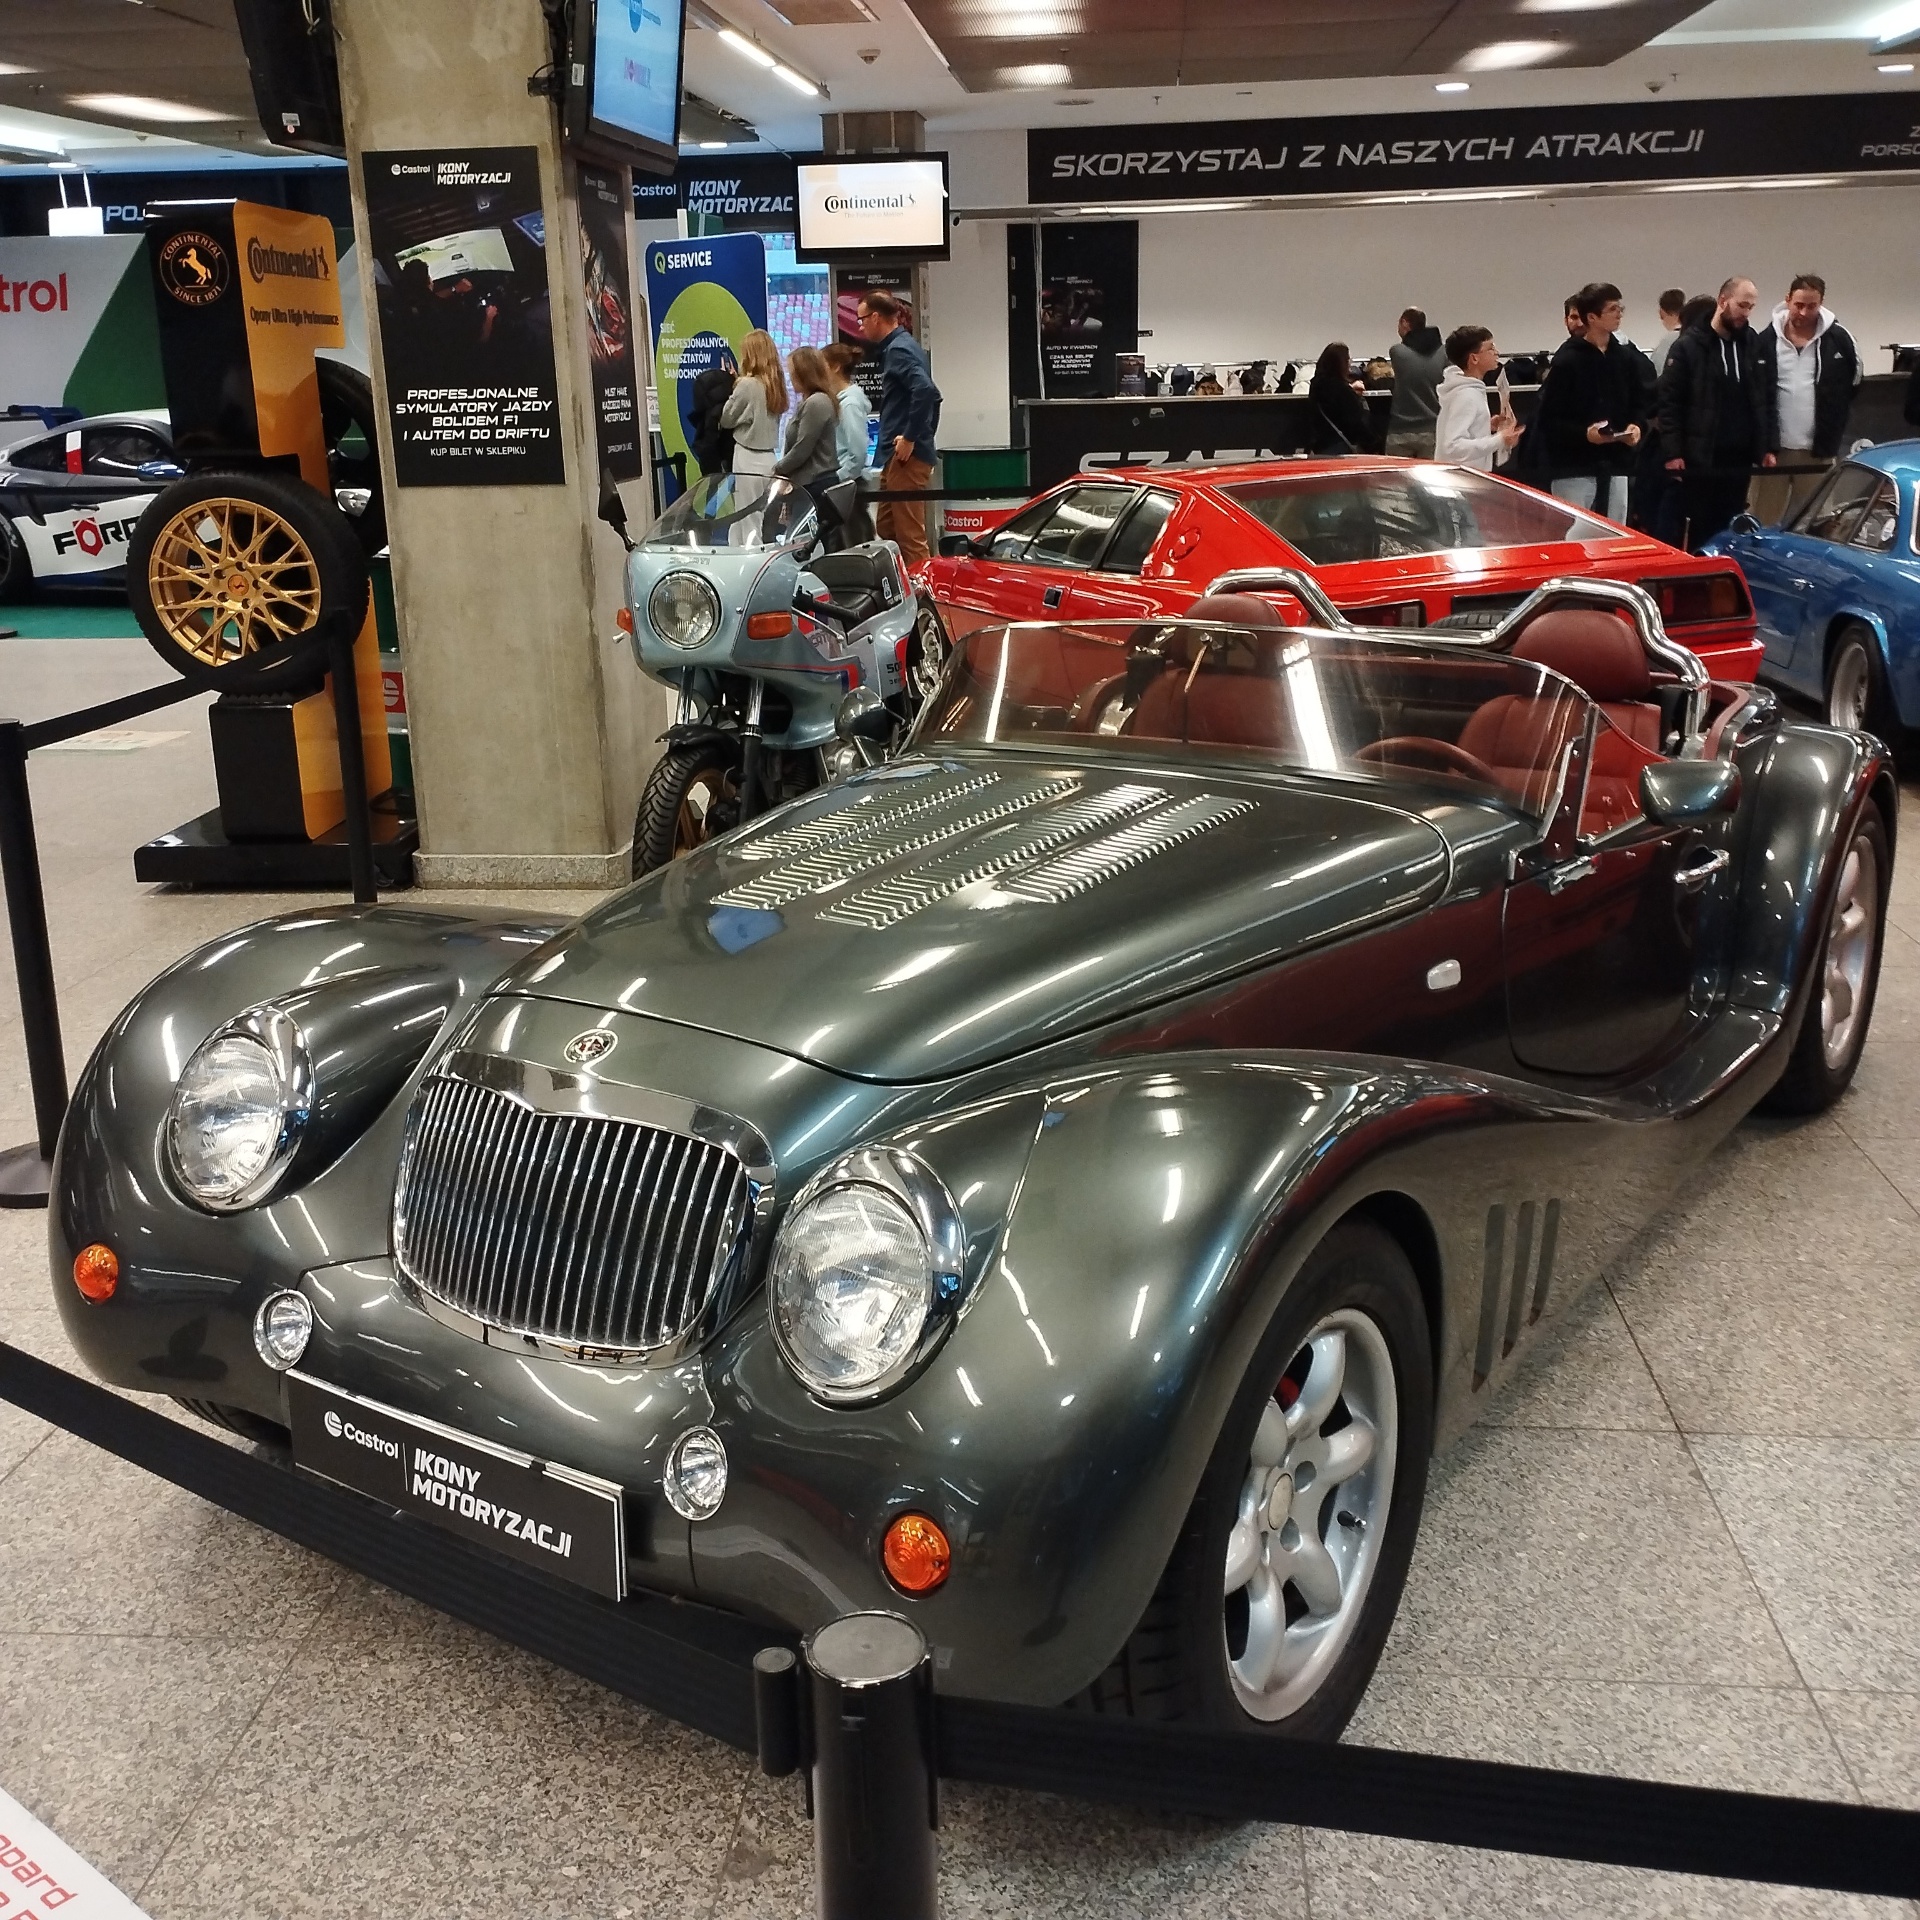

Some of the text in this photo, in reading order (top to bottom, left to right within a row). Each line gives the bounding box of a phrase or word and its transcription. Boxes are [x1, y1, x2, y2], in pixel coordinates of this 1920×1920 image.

[1052, 129, 1704, 178] SKORZYSTAJ Z NASZYCH ATRAKCJI
[401, 164, 431, 174] Castrol
[437, 162, 470, 174] IKONY
[437, 172, 512, 185] MOTORYZACJI
[632, 184, 676, 197] Castrol
[689, 179, 742, 197] IKONY
[824, 194, 904, 214] Continental
[162, 234, 222, 262] CONTINENTAL
[247, 235, 320, 284] Continental
[654, 250, 712, 275] Q SERVICE
[174, 285, 222, 304] SINCE 1871
[661, 337, 729, 349] PROFESJONALNYCH
[662, 351, 712, 364] WARSZTATÓW
[407, 387, 539, 400] PROFESJONALNE
[395, 400, 553, 414] SYMULATORY JAZDY
[432, 415, 519, 427] BOLIDEM F1
[403, 428, 551, 441] I AUTEM DO DRIFTU
[430, 446, 526, 456] KUP BILET W SKLEPIKU
[947, 515, 983, 528] Castrol
[343, 1422, 399, 1459] Castrol
[413, 1447, 482, 1492] IKONY
[412, 1476, 573, 1558] MOTORYZACJI
